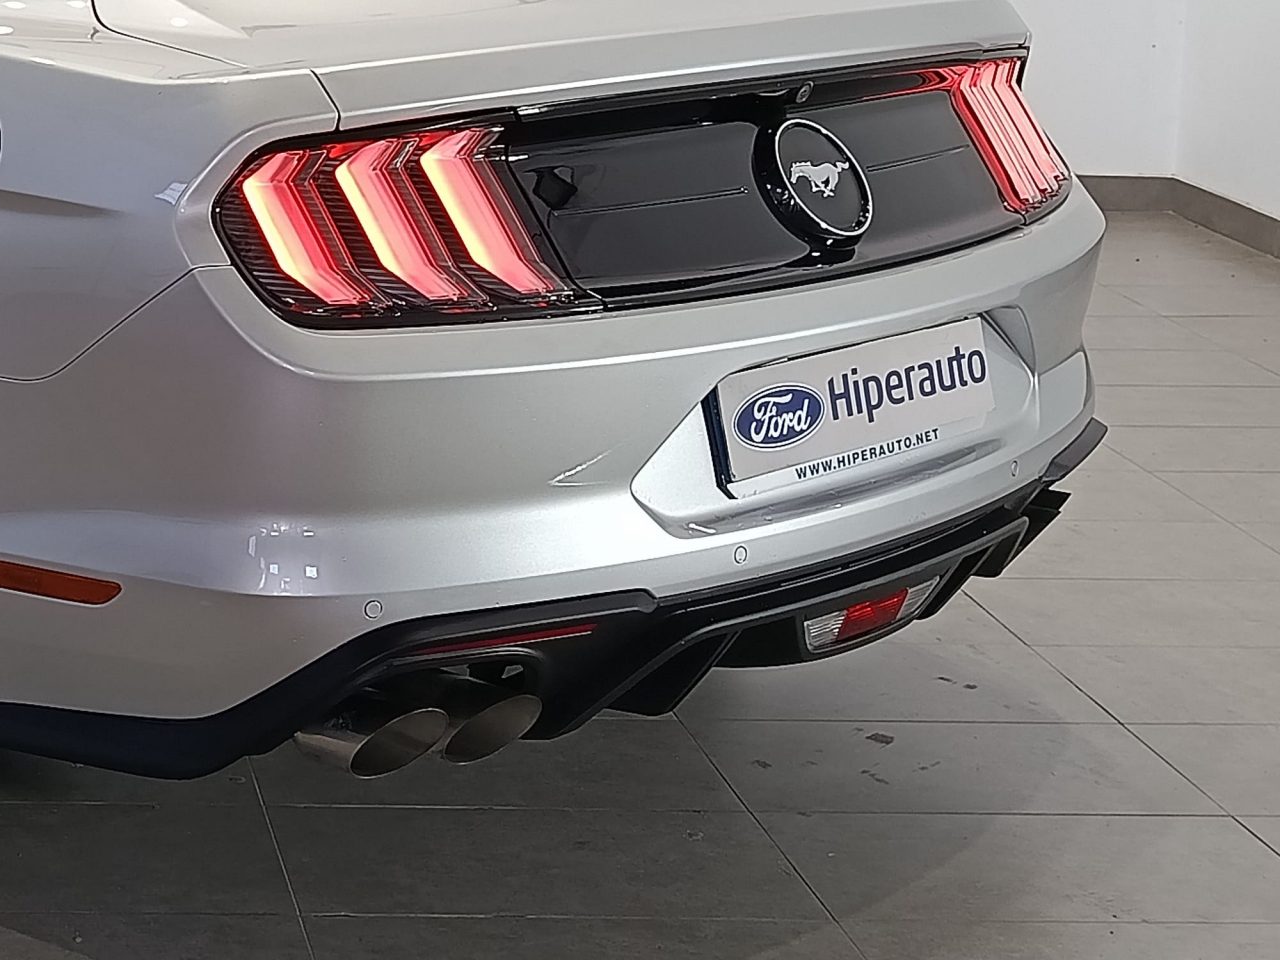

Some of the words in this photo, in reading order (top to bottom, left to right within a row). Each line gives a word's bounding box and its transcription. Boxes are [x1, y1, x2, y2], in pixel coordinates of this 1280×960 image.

[749, 392, 812, 443] Ford
[827, 345, 987, 424] Hiperauto
[794, 428, 940, 480] WWW.HIPERAUTO.NET
